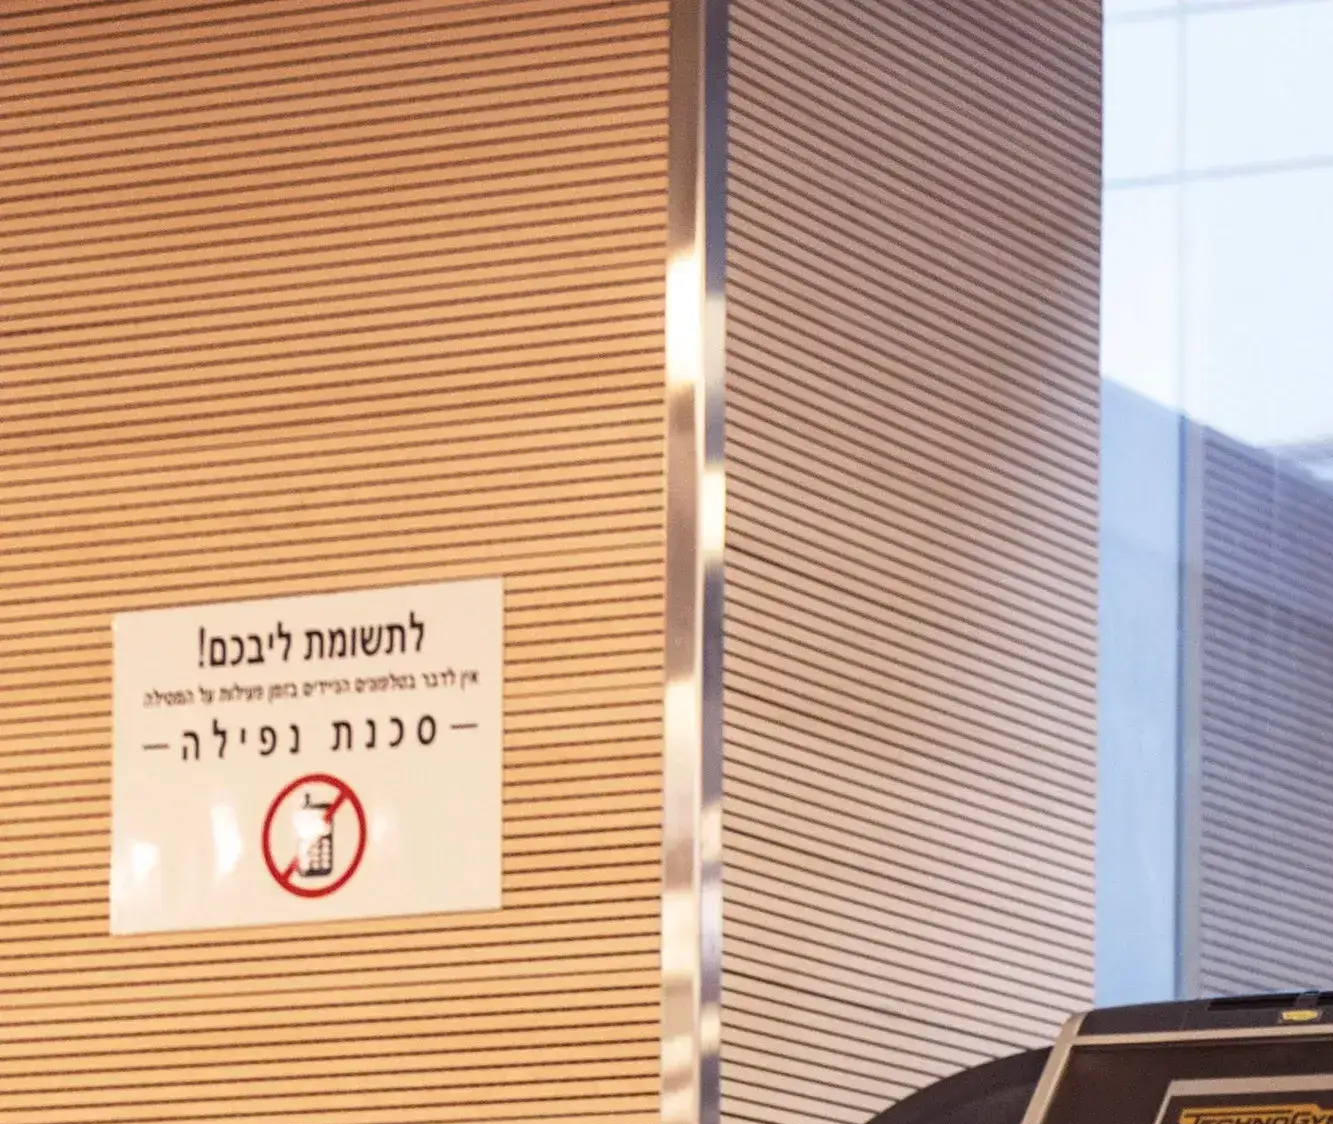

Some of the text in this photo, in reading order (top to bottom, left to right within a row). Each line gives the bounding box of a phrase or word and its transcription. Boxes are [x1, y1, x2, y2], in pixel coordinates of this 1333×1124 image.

[198, 611, 425, 668] לתשומת ליבכם!
[421, 667, 456, 688] לדבר
[460, 670, 479, 691] אין
[181, 714, 437, 761] סכנת נפילה
